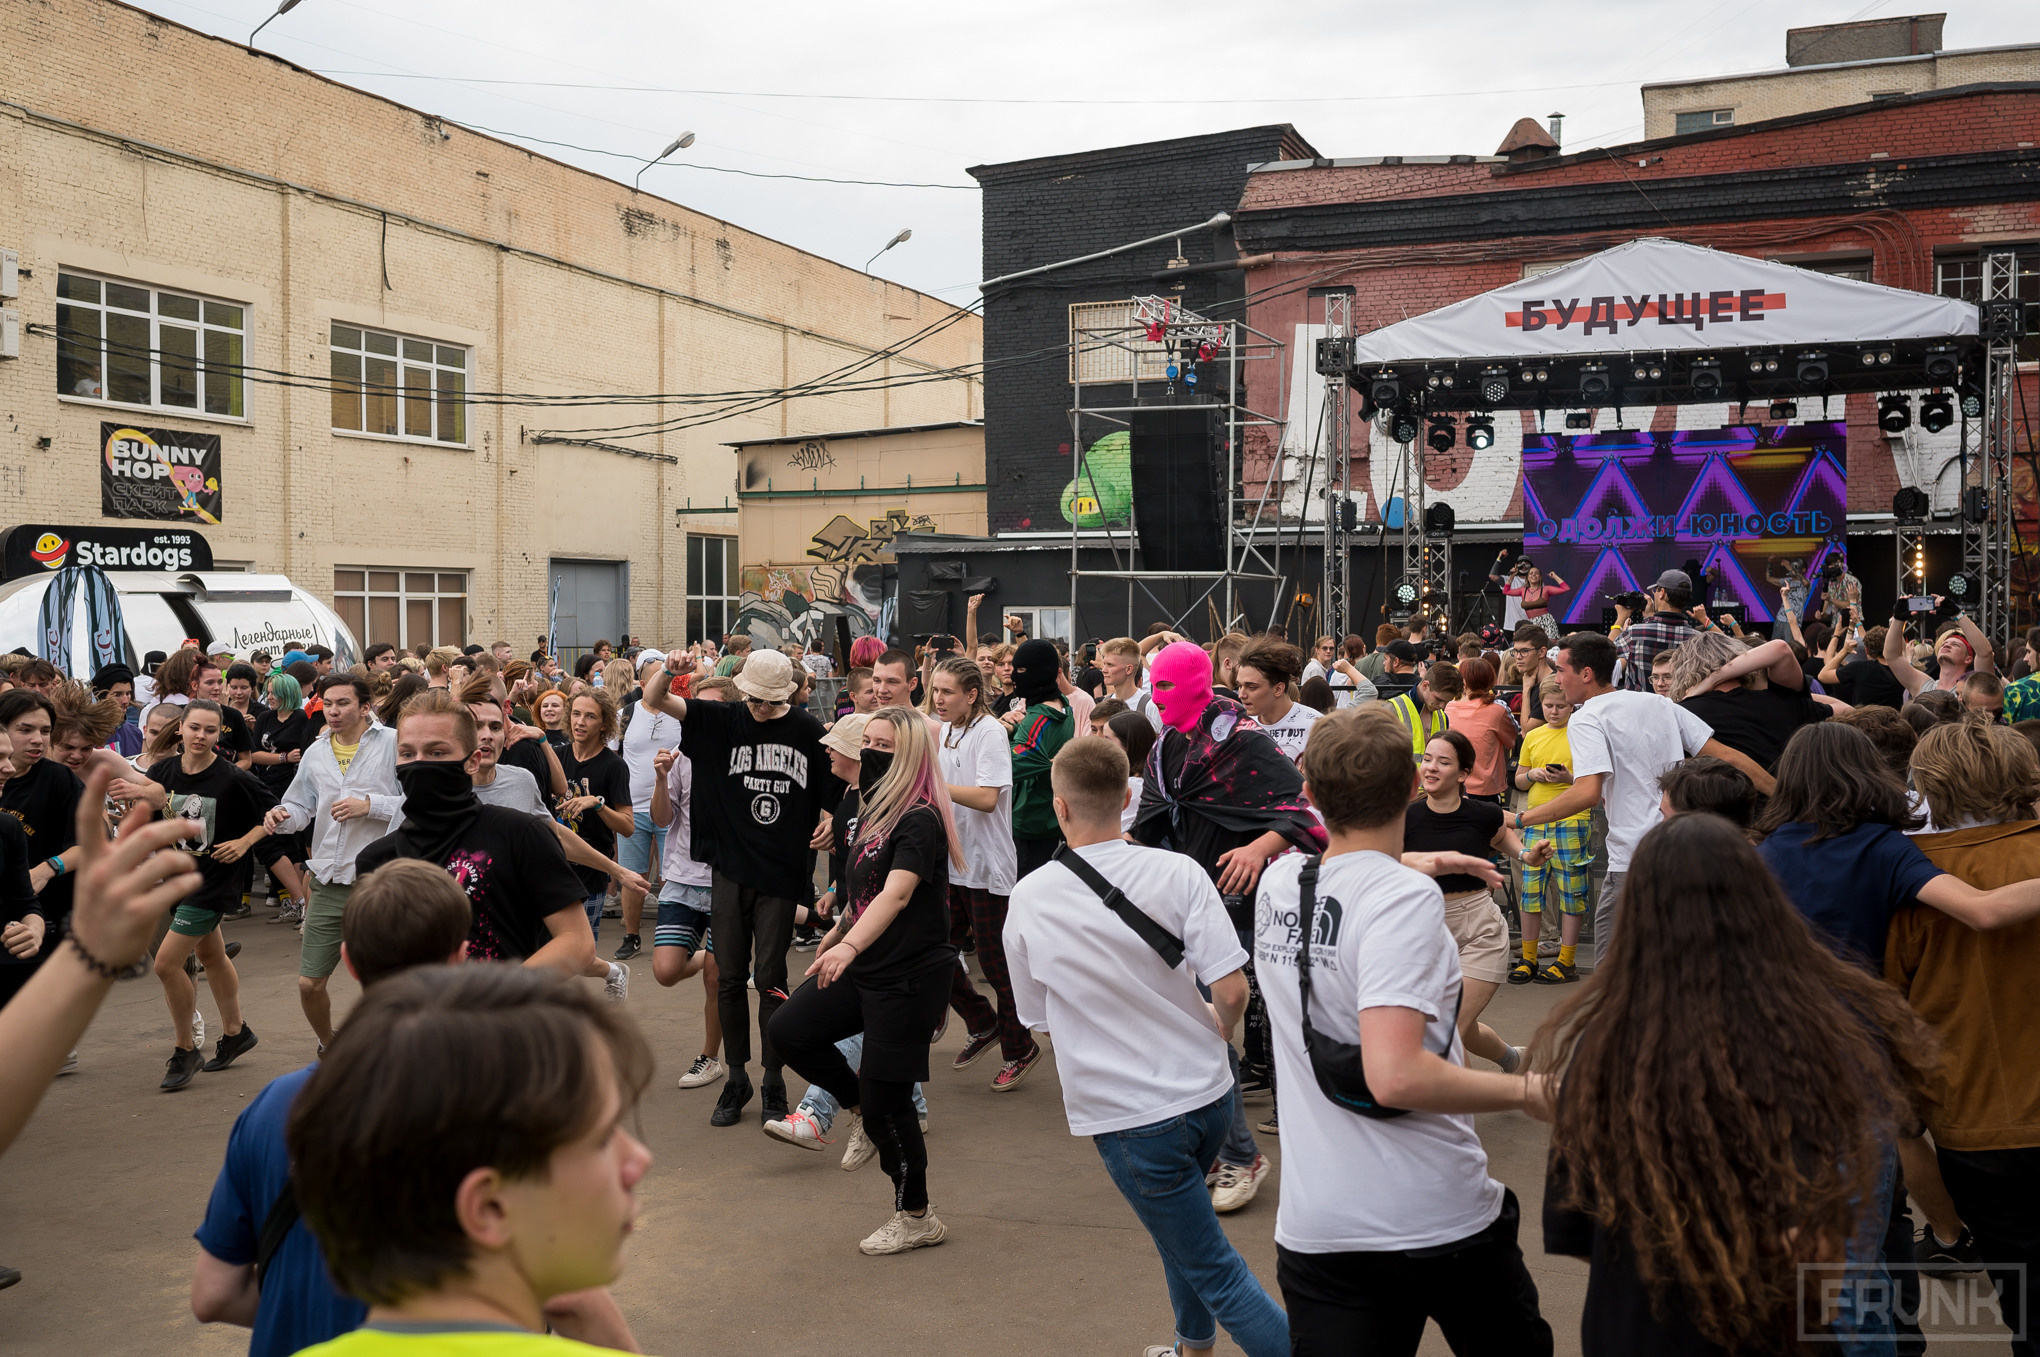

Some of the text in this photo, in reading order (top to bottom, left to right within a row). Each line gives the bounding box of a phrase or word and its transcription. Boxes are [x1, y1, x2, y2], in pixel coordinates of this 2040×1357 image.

[1522, 289, 1765, 335] БУДУЩЕЕ
[111, 440, 207, 466] BUNNY
[111, 458, 171, 480] HOP
[112, 482, 177, 500] СКЕЙТ
[112, 497, 168, 513] ПАРК
[1690, 510, 1833, 537] ЮНОСТЬ
[154, 535, 191, 545] est. 1993
[76, 541, 192, 571] Stardogs
[234, 621, 313, 650] Легендарные
[728, 743, 808, 790] LOS ANGELES
[743, 775, 791, 794] PARTY GUY
[760, 800, 772, 818] G
[462, 861, 478, 883] LEADER
